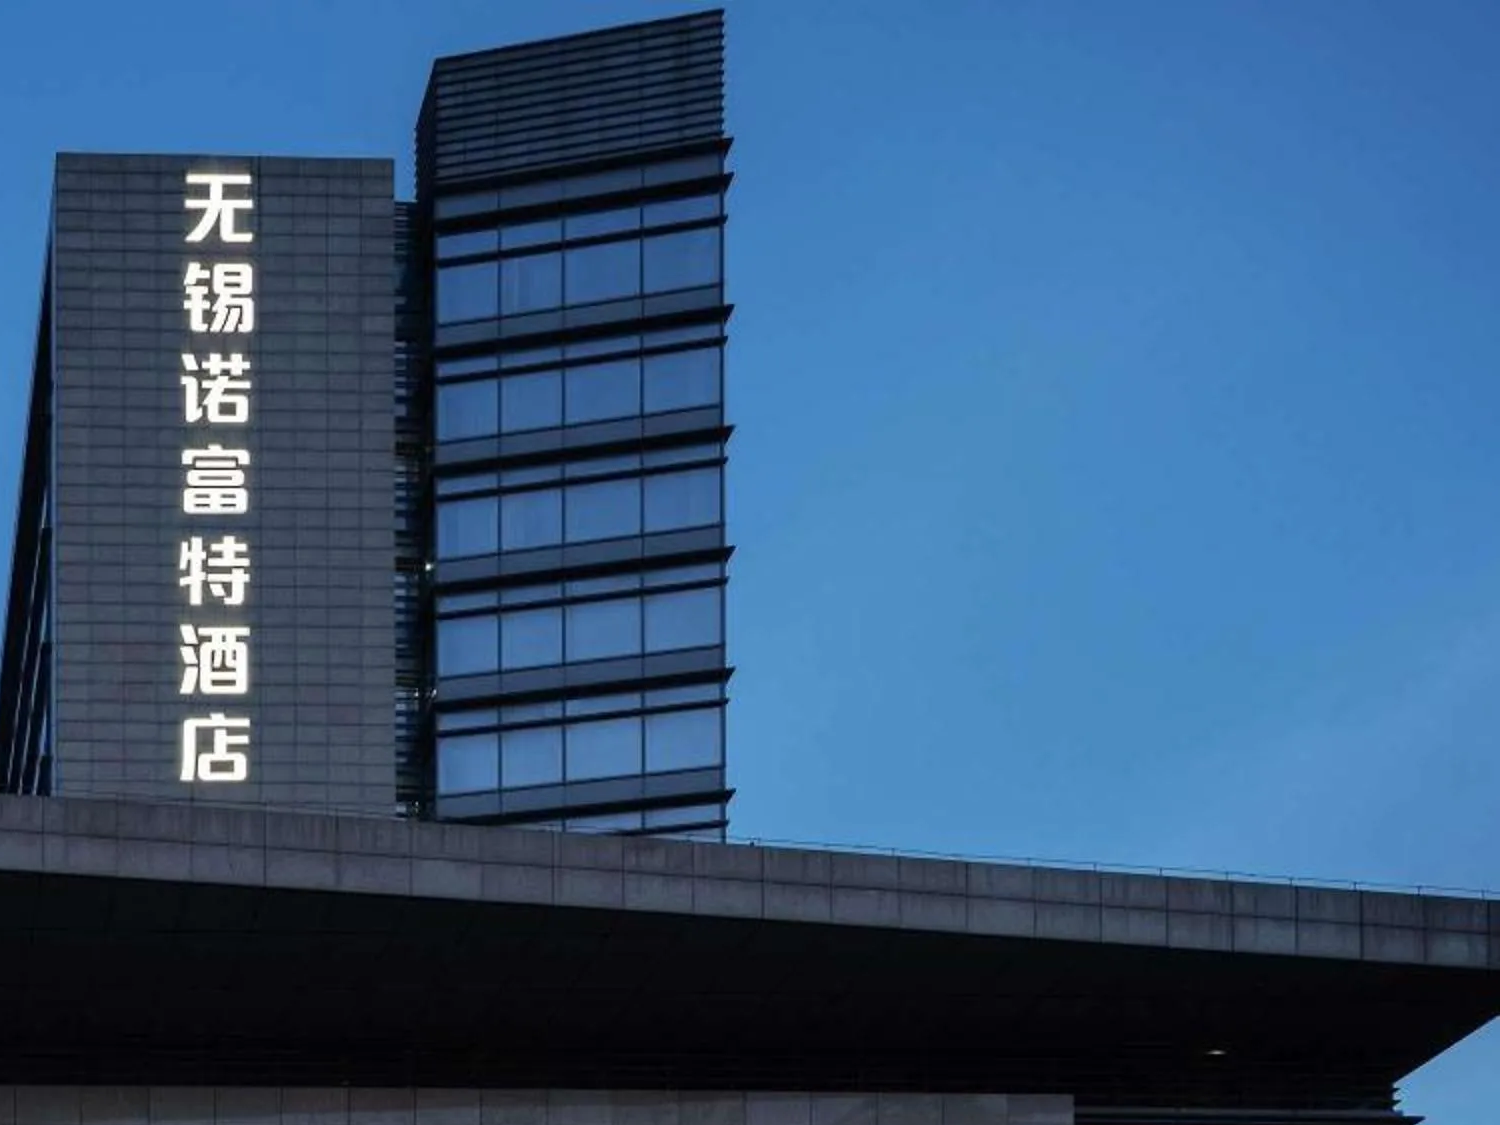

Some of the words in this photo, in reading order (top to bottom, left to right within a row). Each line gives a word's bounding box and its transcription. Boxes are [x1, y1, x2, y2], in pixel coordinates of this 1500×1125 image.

[179, 173, 254, 782] 无锡诺富特酒店
